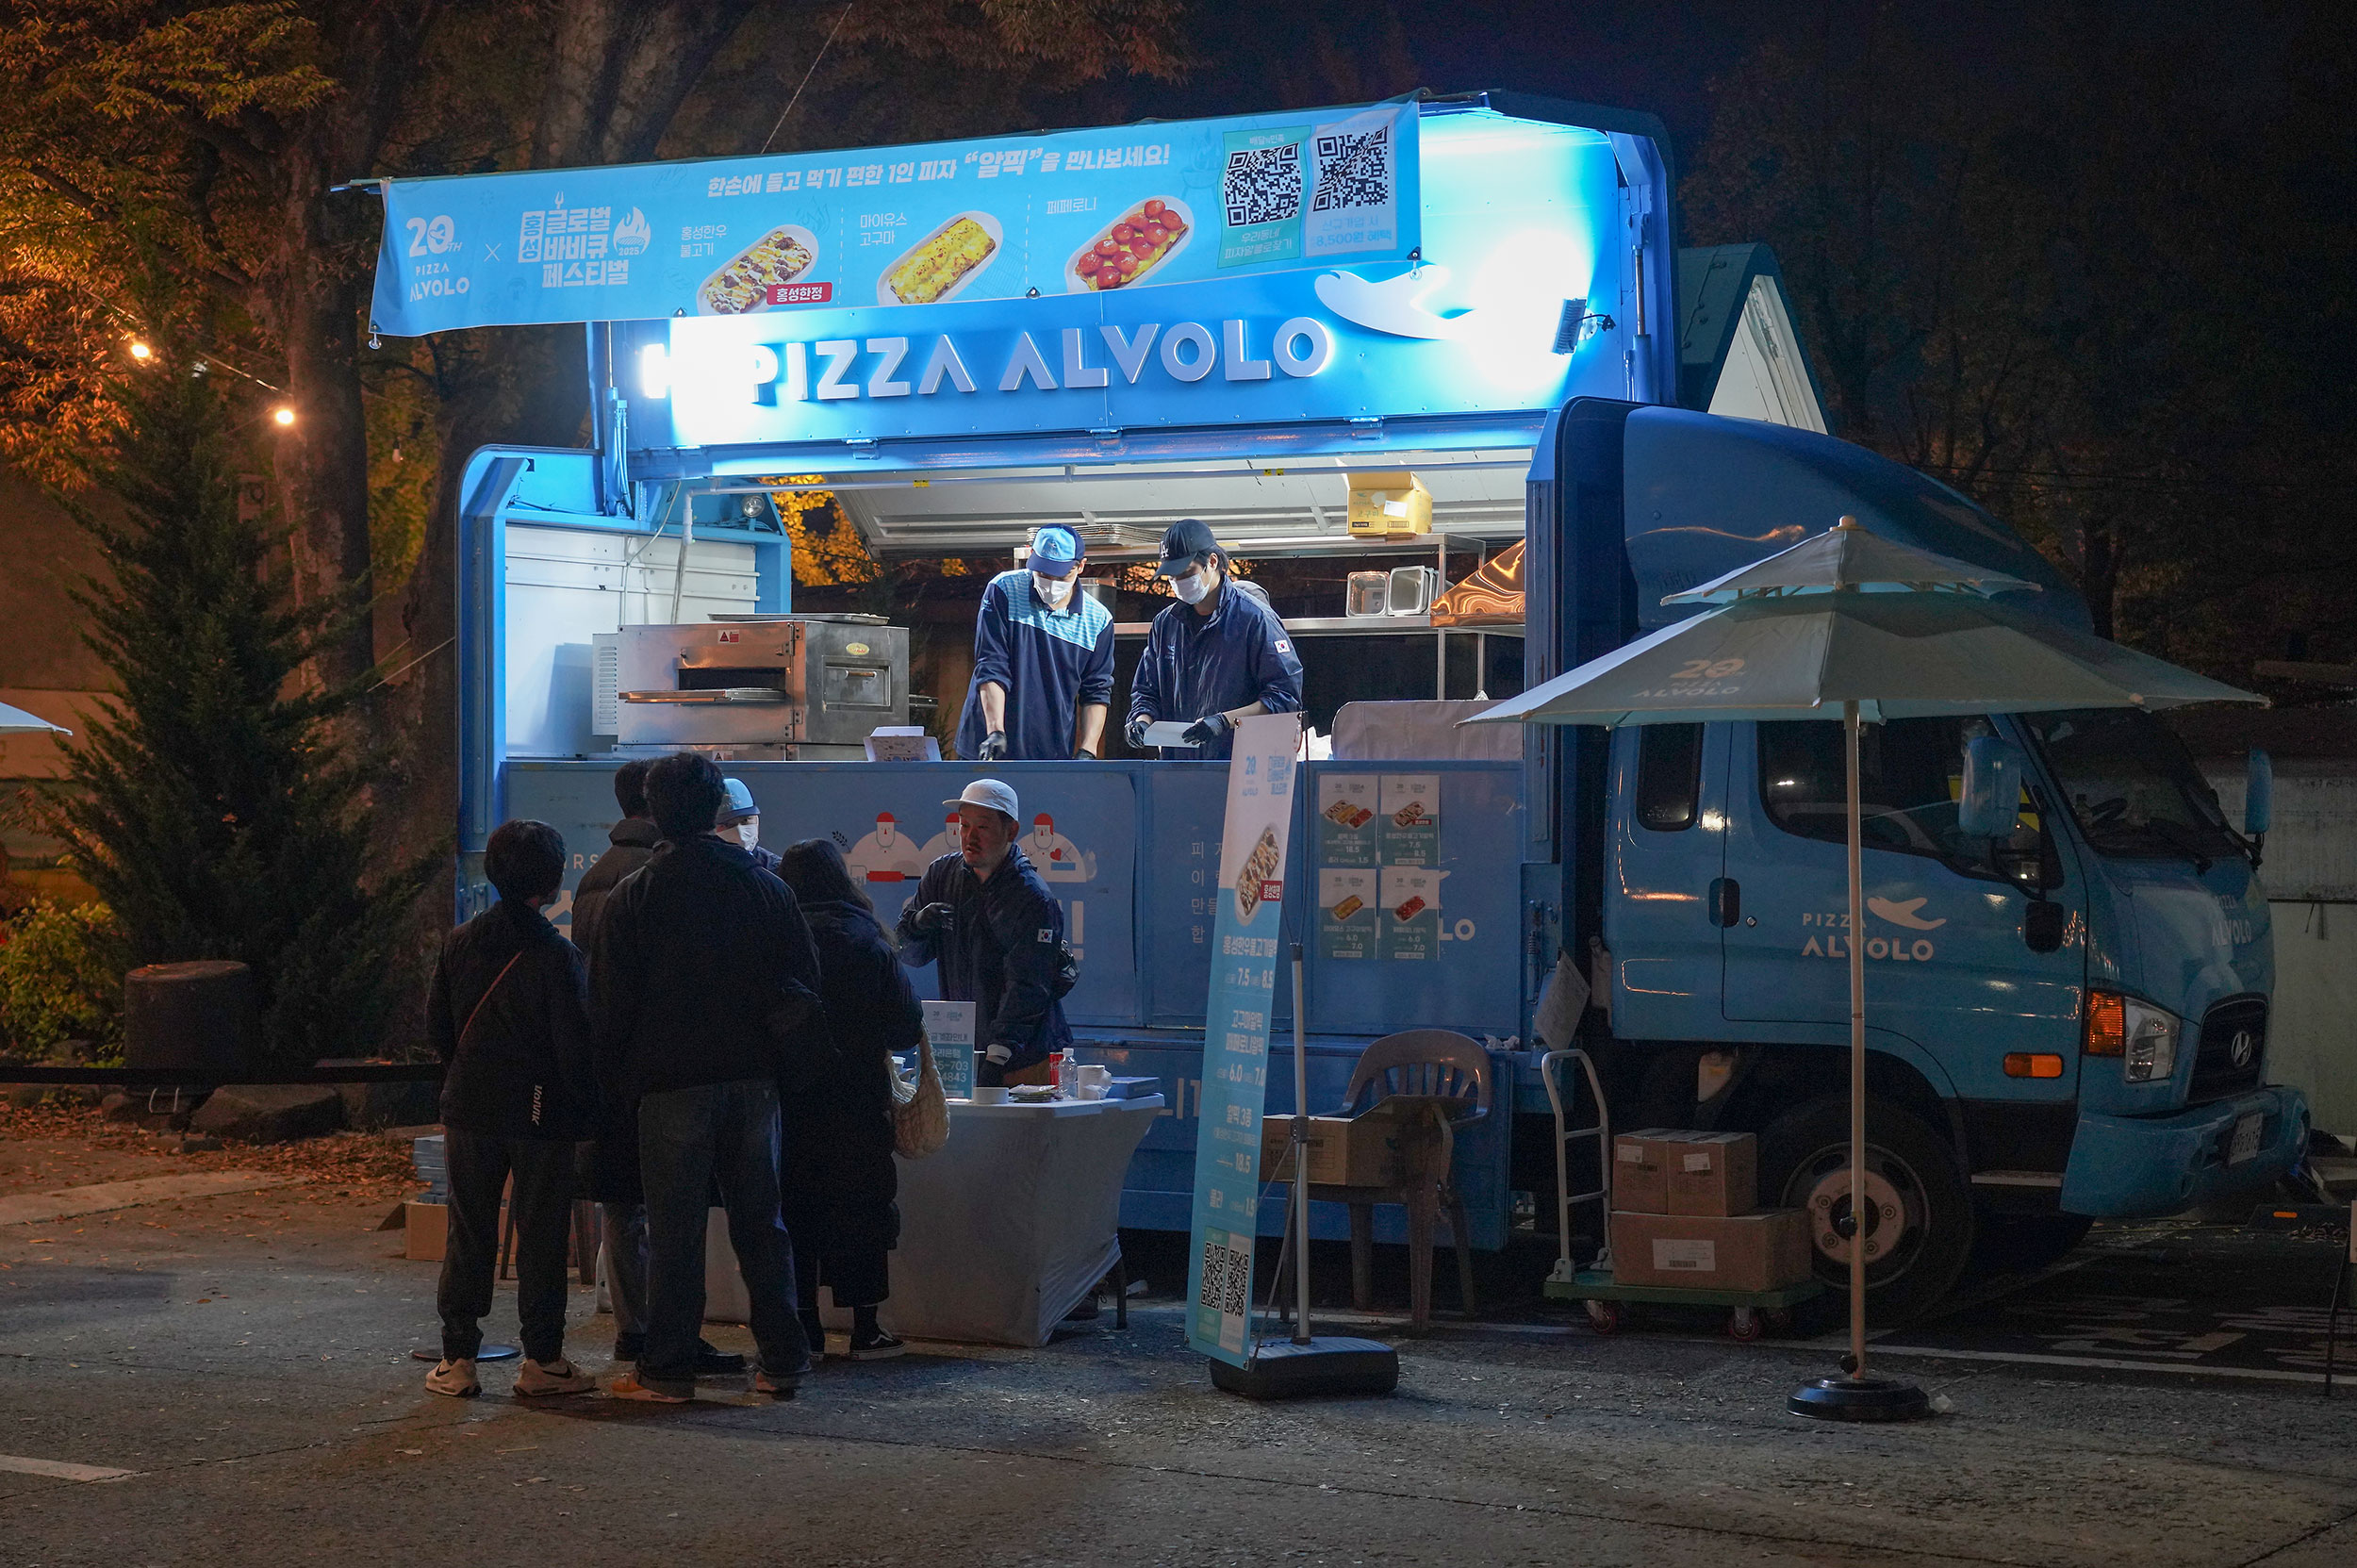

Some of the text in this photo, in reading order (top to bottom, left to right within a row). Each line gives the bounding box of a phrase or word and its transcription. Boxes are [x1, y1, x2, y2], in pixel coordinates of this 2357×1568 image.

[708, 174, 762, 198] 한손에
[765, 170, 800, 193] 들고
[805, 167, 841, 190] 먹기
[847, 164, 884, 187] 편한
[888, 162, 914, 184] 1인
[919, 158, 957, 181] 피자
[1064, 143, 1170, 171] 만나보세요!
[1047, 196, 1096, 215] 페페로니
[546, 206, 611, 235] 글로벌
[860, 212, 907, 229] 마이유스
[523, 213, 544, 260] 홍성
[681, 224, 727, 241] 홍성한우
[859, 230, 895, 247] 고구마
[543, 234, 608, 261] 바비큐
[618, 246, 640, 256] 2025
[680, 242, 715, 258] 불고기
[416, 262, 450, 276] PIZZA
[542, 259, 629, 288] 페스티벌
[409, 277, 470, 302] ALVOLO
[776, 286, 823, 303] 홍성한정
[749, 316, 1330, 404] PIZZA ALVOLO
[1238, 967, 1250, 986] 7.5
[1262, 969, 1274, 989] 8.5
[1229, 1064, 1243, 1082] 6.0
[1236, 1152, 1251, 1174] 18.5
